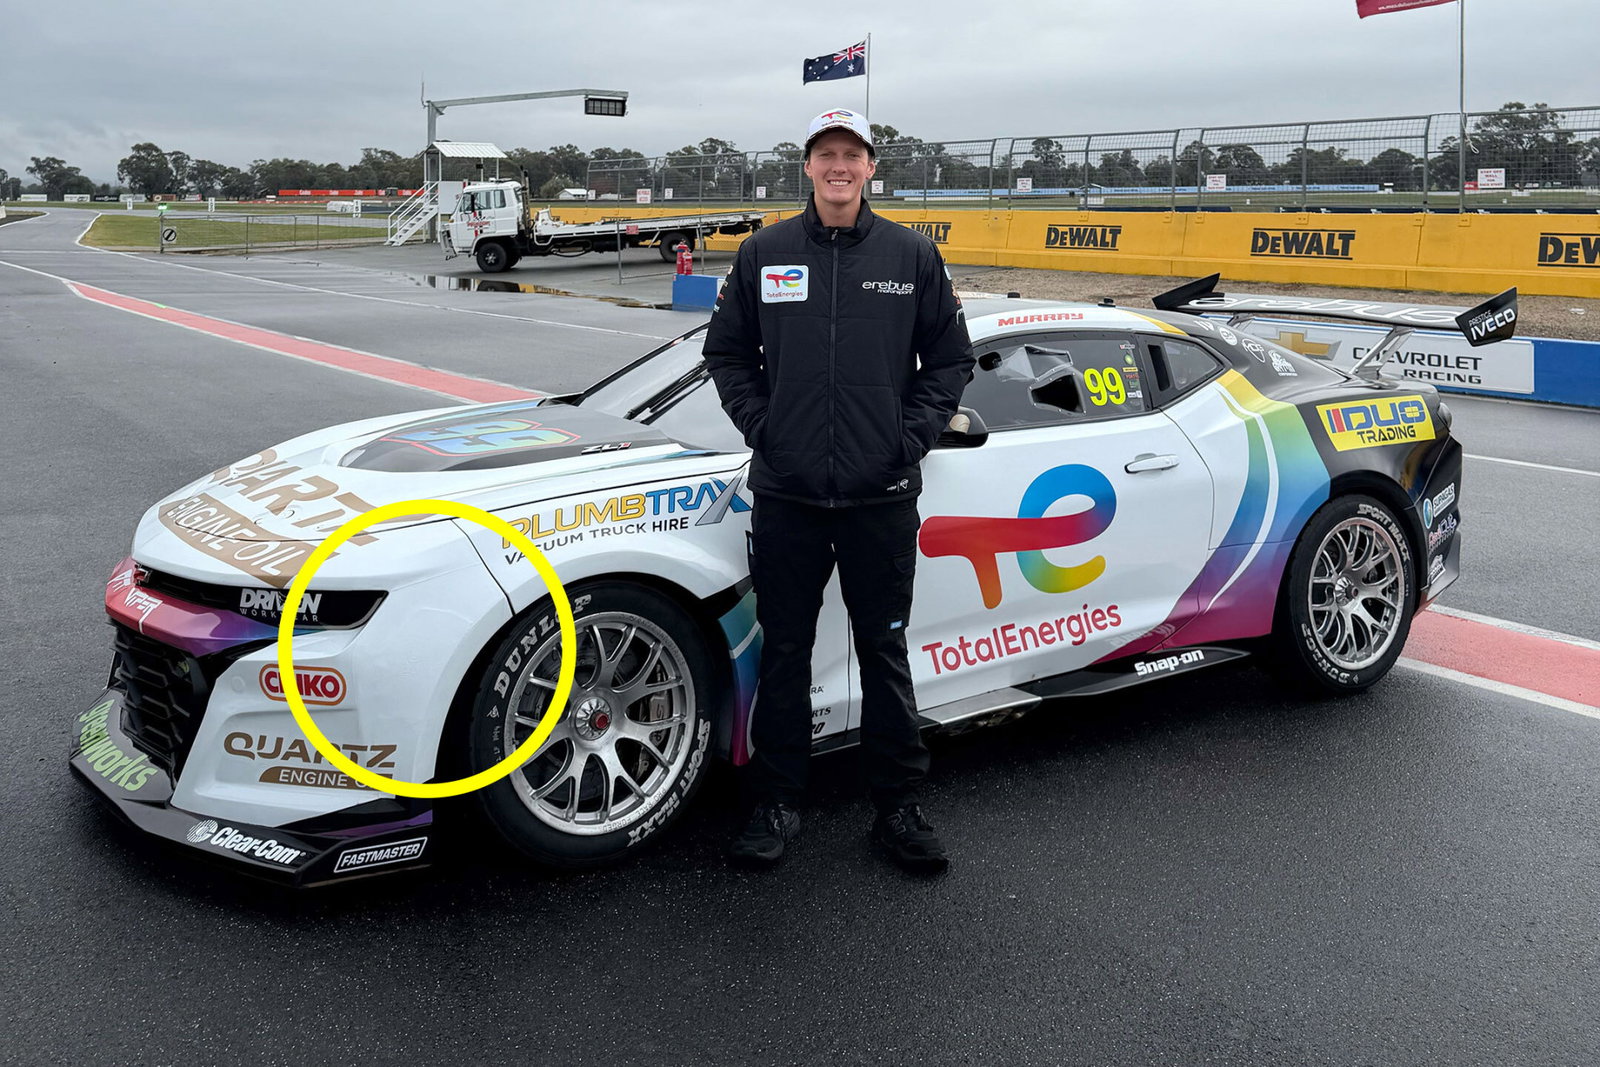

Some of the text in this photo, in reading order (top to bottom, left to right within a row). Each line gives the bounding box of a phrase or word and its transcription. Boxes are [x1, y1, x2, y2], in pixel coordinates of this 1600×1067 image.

[862, 280, 914, 291] erebus
[998, 313, 1084, 327] MURRAY
[1469, 309, 1492, 328] PRESTIGE
[1470, 308, 1516, 341] IVECO
[1083, 366, 1127, 406] 99
[1403, 368, 1483, 385] RACING
[1357, 425, 1416, 443] TRADING
[1357, 504, 1392, 524] SPORT
[167, 497, 306, 576] ENGINE OIL
[589, 522, 647, 539] TRUCK
[651, 517, 689, 533] HIRE
[240, 588, 322, 614] DRIVN
[240, 608, 318, 622] WORKAR
[494, 594, 592, 699] DUNLP
[922, 604, 1122, 675] TotalEnergies
[1134, 649, 1205, 676] Snap-on
[265, 671, 340, 698] CIKO
[279, 769, 348, 787] ENGINE
[210, 827, 300, 864] Clear-Com
[340, 842, 421, 867] FASTMASTER
